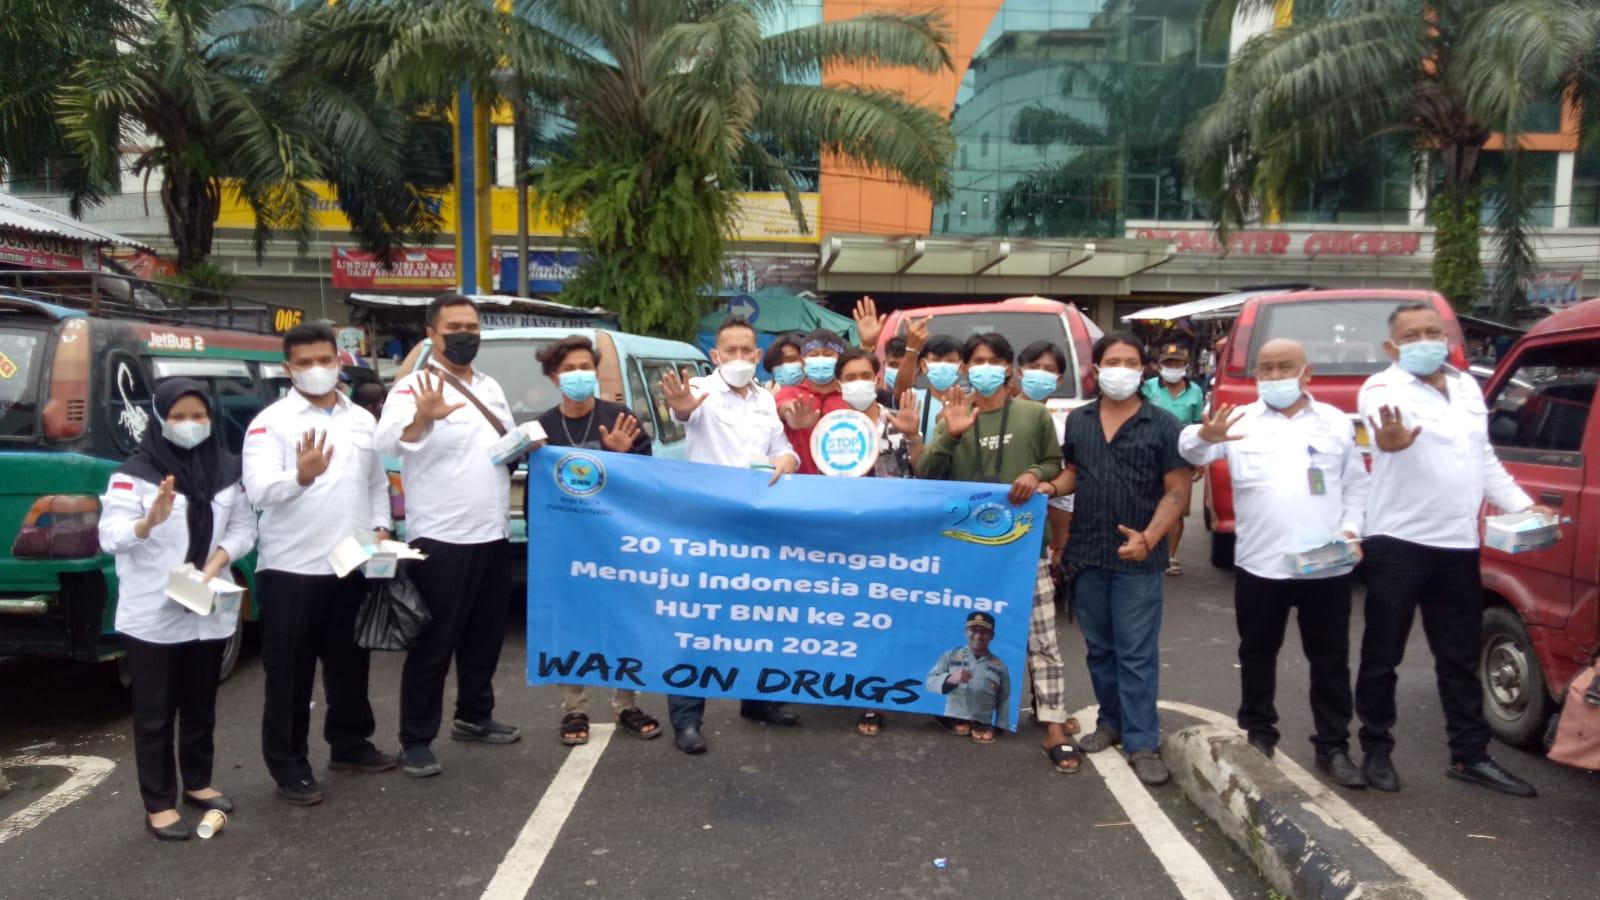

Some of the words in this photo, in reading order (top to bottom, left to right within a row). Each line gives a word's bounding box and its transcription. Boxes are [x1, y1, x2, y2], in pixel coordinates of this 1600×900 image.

[148, 331, 192, 350] JetBus
[194, 335, 204, 350] 2
[828, 437, 860, 448] STOP
[620, 535, 662, 554] 20
[669, 538, 770, 560] Tahun
[779, 545, 940, 575] Mengabdi
[570, 560, 690, 590] Menuju
[699, 571, 860, 597] Indonesia
[868, 581, 1009, 614] Bersinar
[655, 599, 722, 620] HUT
[730, 604, 799, 624] BNN
[807, 606, 845, 626] ke
[852, 611, 893, 631] 20
[674, 631, 774, 652] Tahun
[781, 636, 858, 658] 2022
[537, 650, 647, 687] WAR
[662, 662, 739, 692] ON
[756, 667, 924, 704] DRUGS
